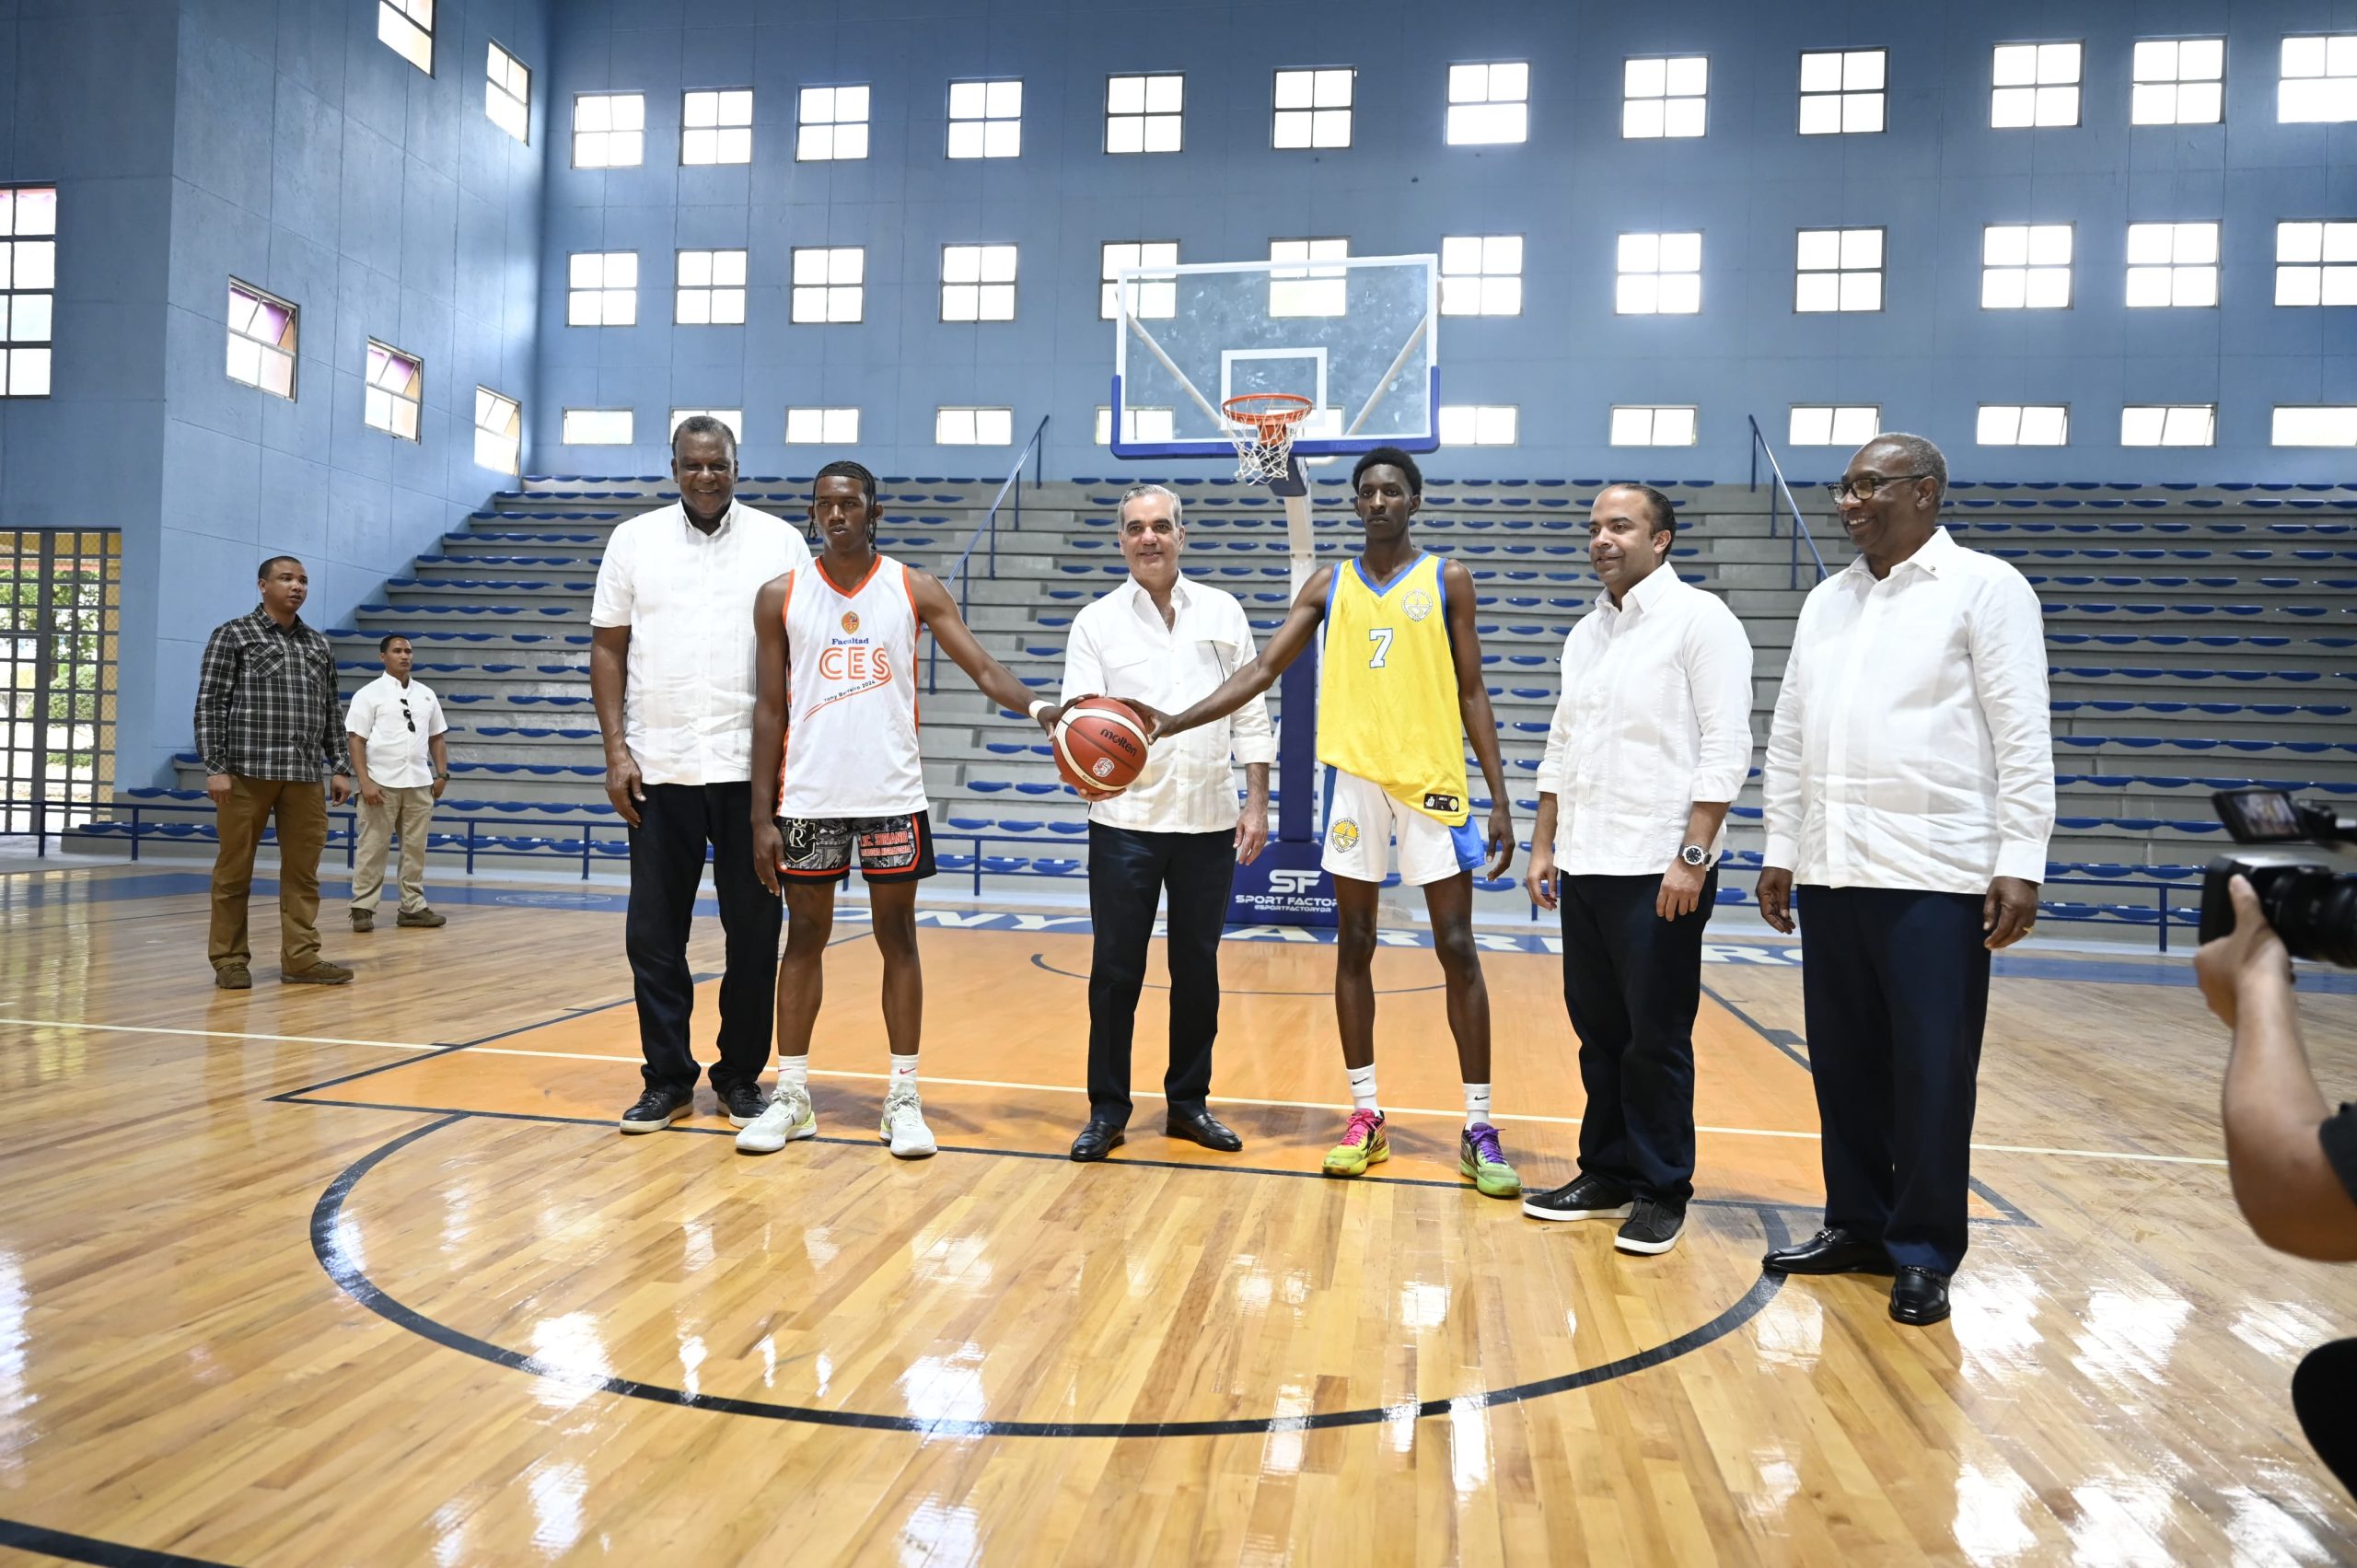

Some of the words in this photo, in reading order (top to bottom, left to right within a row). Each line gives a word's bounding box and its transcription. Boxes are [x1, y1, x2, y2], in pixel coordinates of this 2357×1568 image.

[831, 637, 869, 645] Facultad
[1369, 628, 1393, 668] 7
[819, 646, 892, 680] CES
[862, 679, 876, 688] 2024
[1100, 728, 1137, 757] molten
[1268, 869, 1322, 894] SF
[1235, 895, 1284, 904] SPORT
[1287, 897, 1338, 907] FACTOR
